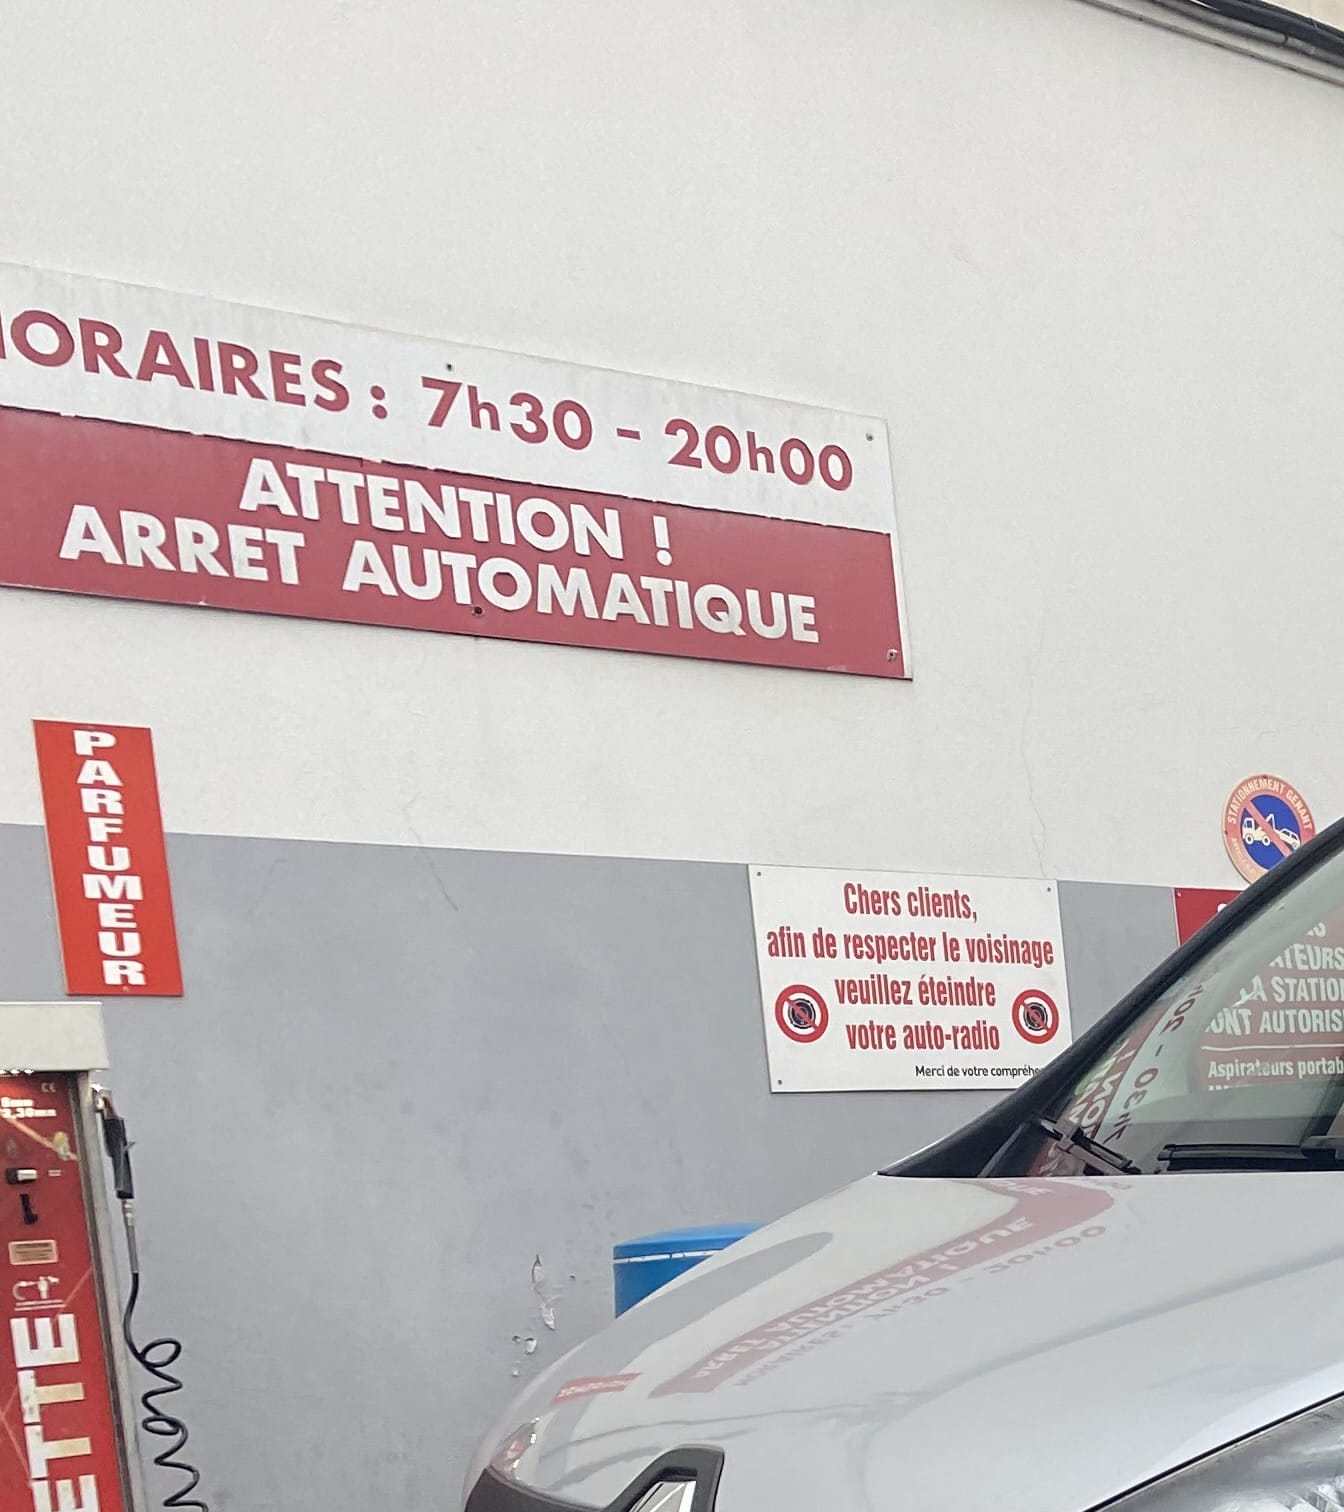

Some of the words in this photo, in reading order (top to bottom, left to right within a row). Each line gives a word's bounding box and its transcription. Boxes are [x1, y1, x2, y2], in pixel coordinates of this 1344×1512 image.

[0, 310, 351, 414] ORAIRES
[420, 376, 593, 451] 7h30
[665, 417, 854, 493] 20h00
[239, 458, 623, 562] ATTENTION
[654, 516, 673, 567] !
[59, 505, 306, 586] ARRET
[343, 541, 819, 645] AUTOMATIQUE
[1228, 778, 1285, 824] STATIONNEMENT
[73, 730, 146, 985] PARFUMEUR
[844, 882, 902, 916] Chers
[907, 887, 978, 922] clients,
[767, 926, 807, 958] afin
[812, 927, 838, 959] de
[844, 931, 937, 964] respecter
[943, 931, 961, 963] le
[966, 934, 1054, 968] voisinage
[835, 974, 913, 1005] veuillez
[918, 973, 996, 1007] éteindre
[846, 1021, 897, 1050] votre
[903, 1017, 1000, 1051] auto-radio
[1205, 1007, 1252, 1036] ONT
[915, 1065, 945, 1077] Merci
[947, 1065, 960, 1077] de
[962, 1065, 989, 1077] votre
